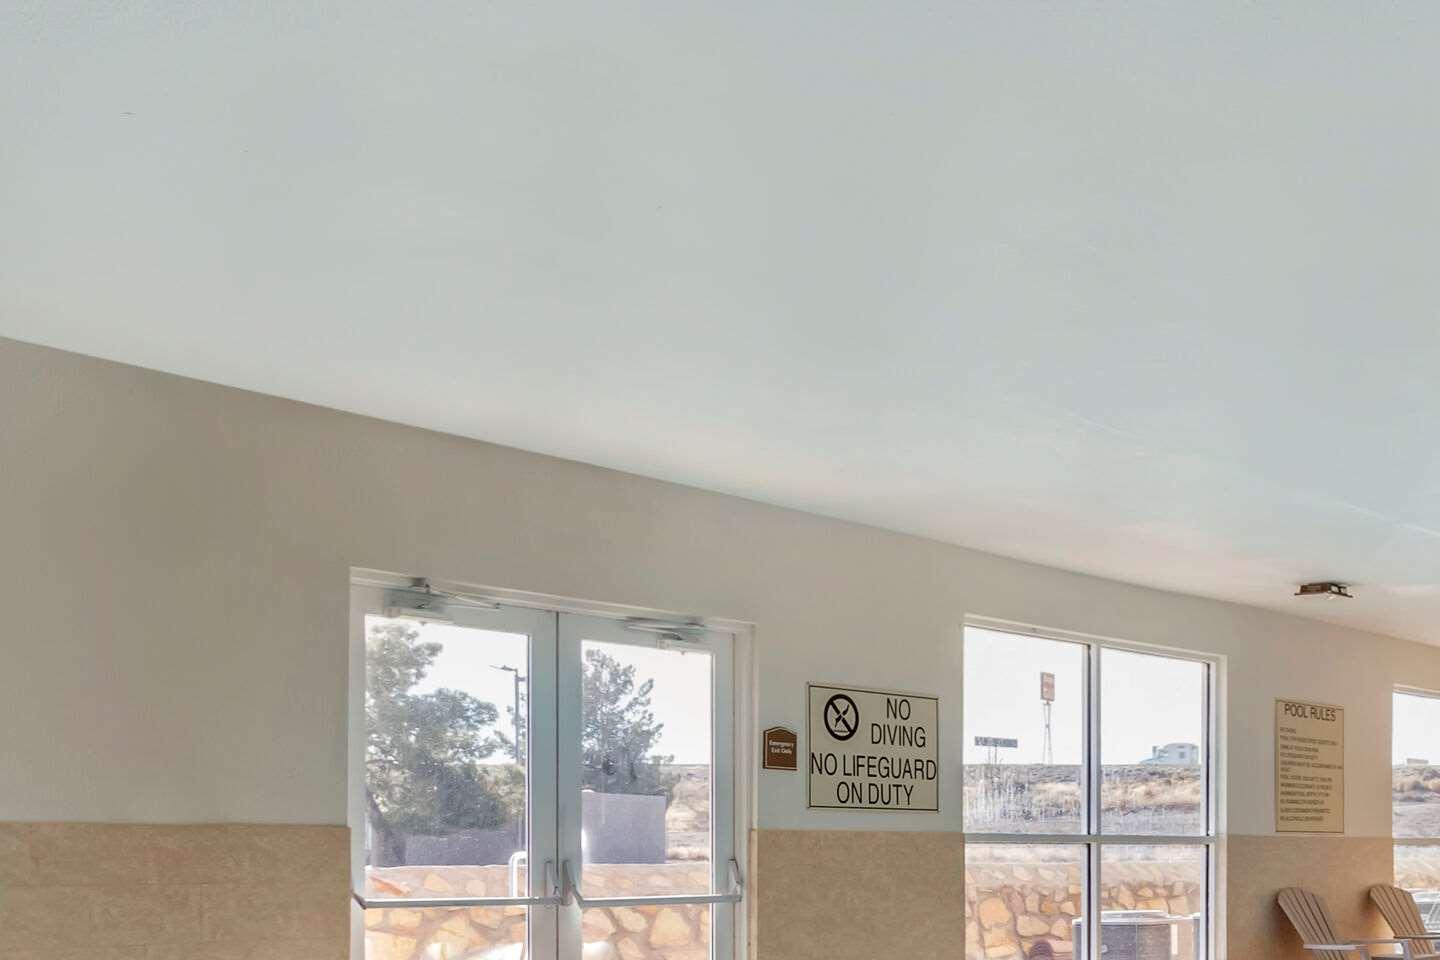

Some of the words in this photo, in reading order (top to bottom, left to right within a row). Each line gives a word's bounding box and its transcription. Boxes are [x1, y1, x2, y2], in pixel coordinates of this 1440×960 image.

[886, 697, 911, 720] NO
[1284, 703, 1308, 719] POOL
[1310, 706, 1337, 722] RULES
[871, 723, 926, 748] DIVING
[811, 752, 838, 776] NO
[843, 754, 937, 780] LIFEGUARD
[836, 781, 863, 804] ON
[868, 783, 914, 805] DUTY
